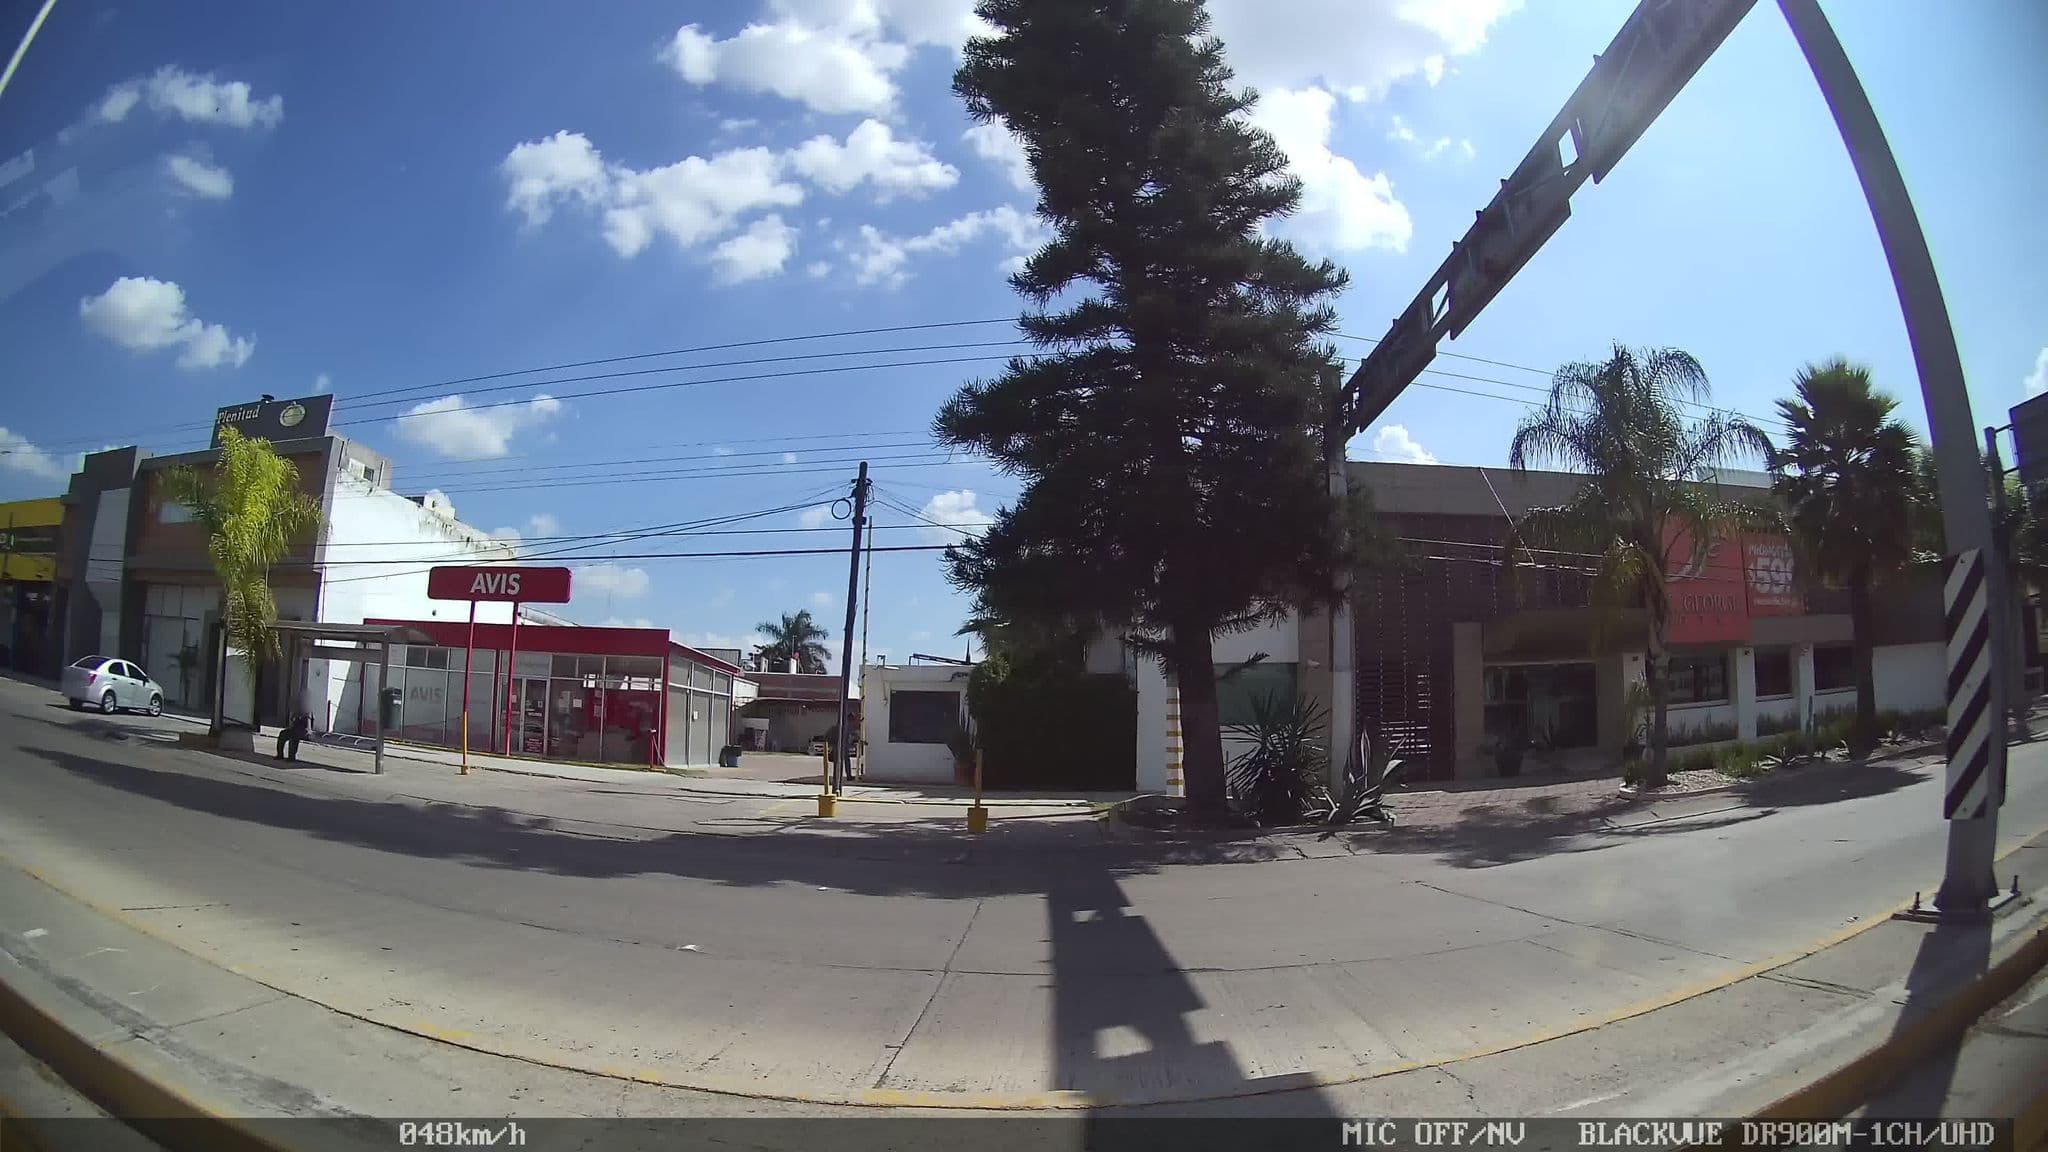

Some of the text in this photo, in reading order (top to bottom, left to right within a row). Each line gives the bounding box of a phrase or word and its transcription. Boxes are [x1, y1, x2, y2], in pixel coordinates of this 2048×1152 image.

[217, 405, 261, 424] Plenitud
[470, 573, 521, 595] AVIS
[410, 686, 442, 702] AVIS
